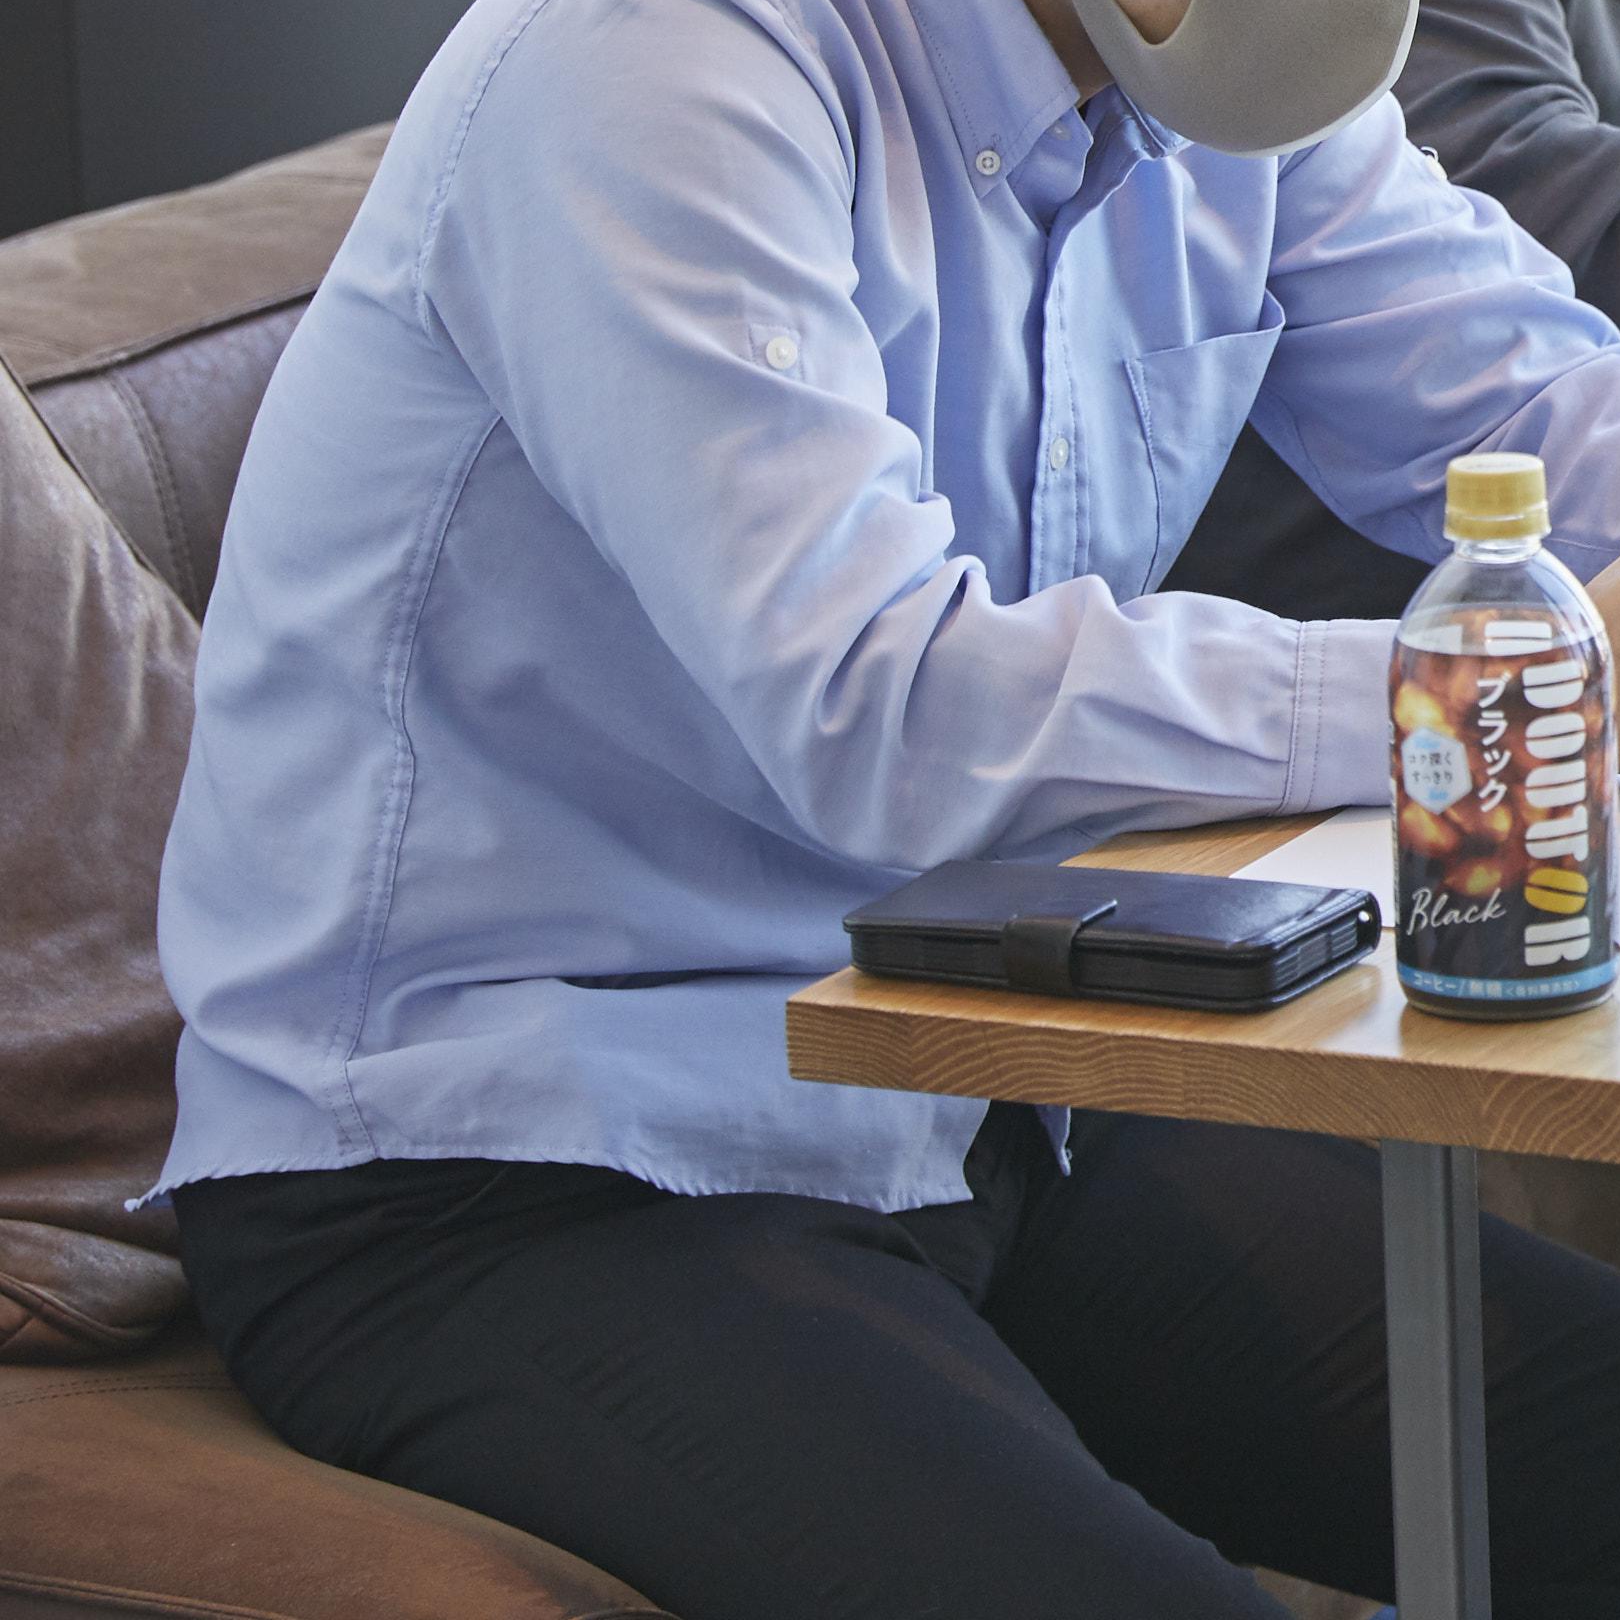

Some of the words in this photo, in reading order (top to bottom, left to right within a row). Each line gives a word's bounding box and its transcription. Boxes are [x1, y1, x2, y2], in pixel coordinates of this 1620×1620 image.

[1411, 770, 1453, 785] すっきり
[1477, 670, 1512, 813] ブラック
[1523, 659, 1591, 967] DOUTOR
[1406, 888, 1508, 936] Black
